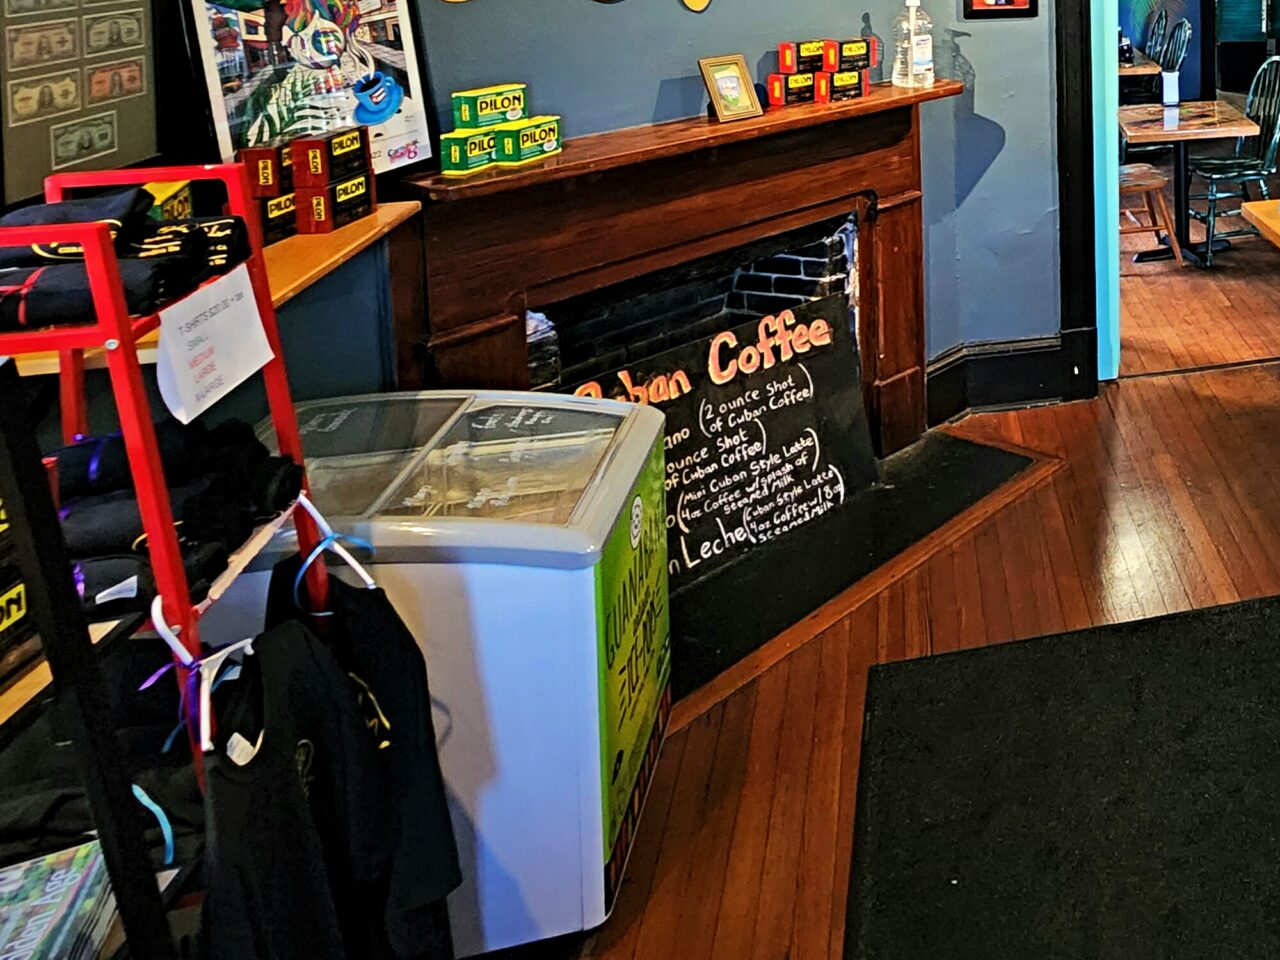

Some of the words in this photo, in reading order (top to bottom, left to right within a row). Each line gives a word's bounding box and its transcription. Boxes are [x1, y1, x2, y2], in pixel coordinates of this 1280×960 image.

[844, 44, 865, 54] PILON
[789, 76, 812, 86] PILON
[834, 73, 857, 84] PILON
[479, 94, 521, 113] PILON
[333, 134, 360, 152] PILON
[468, 137, 496, 155] PILO
[521, 126, 556, 146] PILON
[310, 150, 320, 174] PILON
[260, 161, 271, 185] PILON
[338, 180, 365, 199] PILON
[269, 196, 295, 214] PILO
[575, 370, 692, 405] ban
[707, 309, 832, 385] Coffee
[718, 389, 760, 414] ounce
[709, 417, 723, 432] of
[728, 405, 767, 427] Cuban
[666, 447, 709, 473] ounce
[682, 462, 718, 484] Cuban
[709, 471, 748, 492] Cuban
[750, 453, 782, 477] Style
[680, 507, 703, 522] 4oz
[704, 489, 741, 513] Coffee
[795, 451, 809, 467] of
[771, 475, 795, 492] Milk
[750, 520, 772, 533] 4oz
[680, 517, 747, 569] Leche
[30, 868, 81, 907] Age
